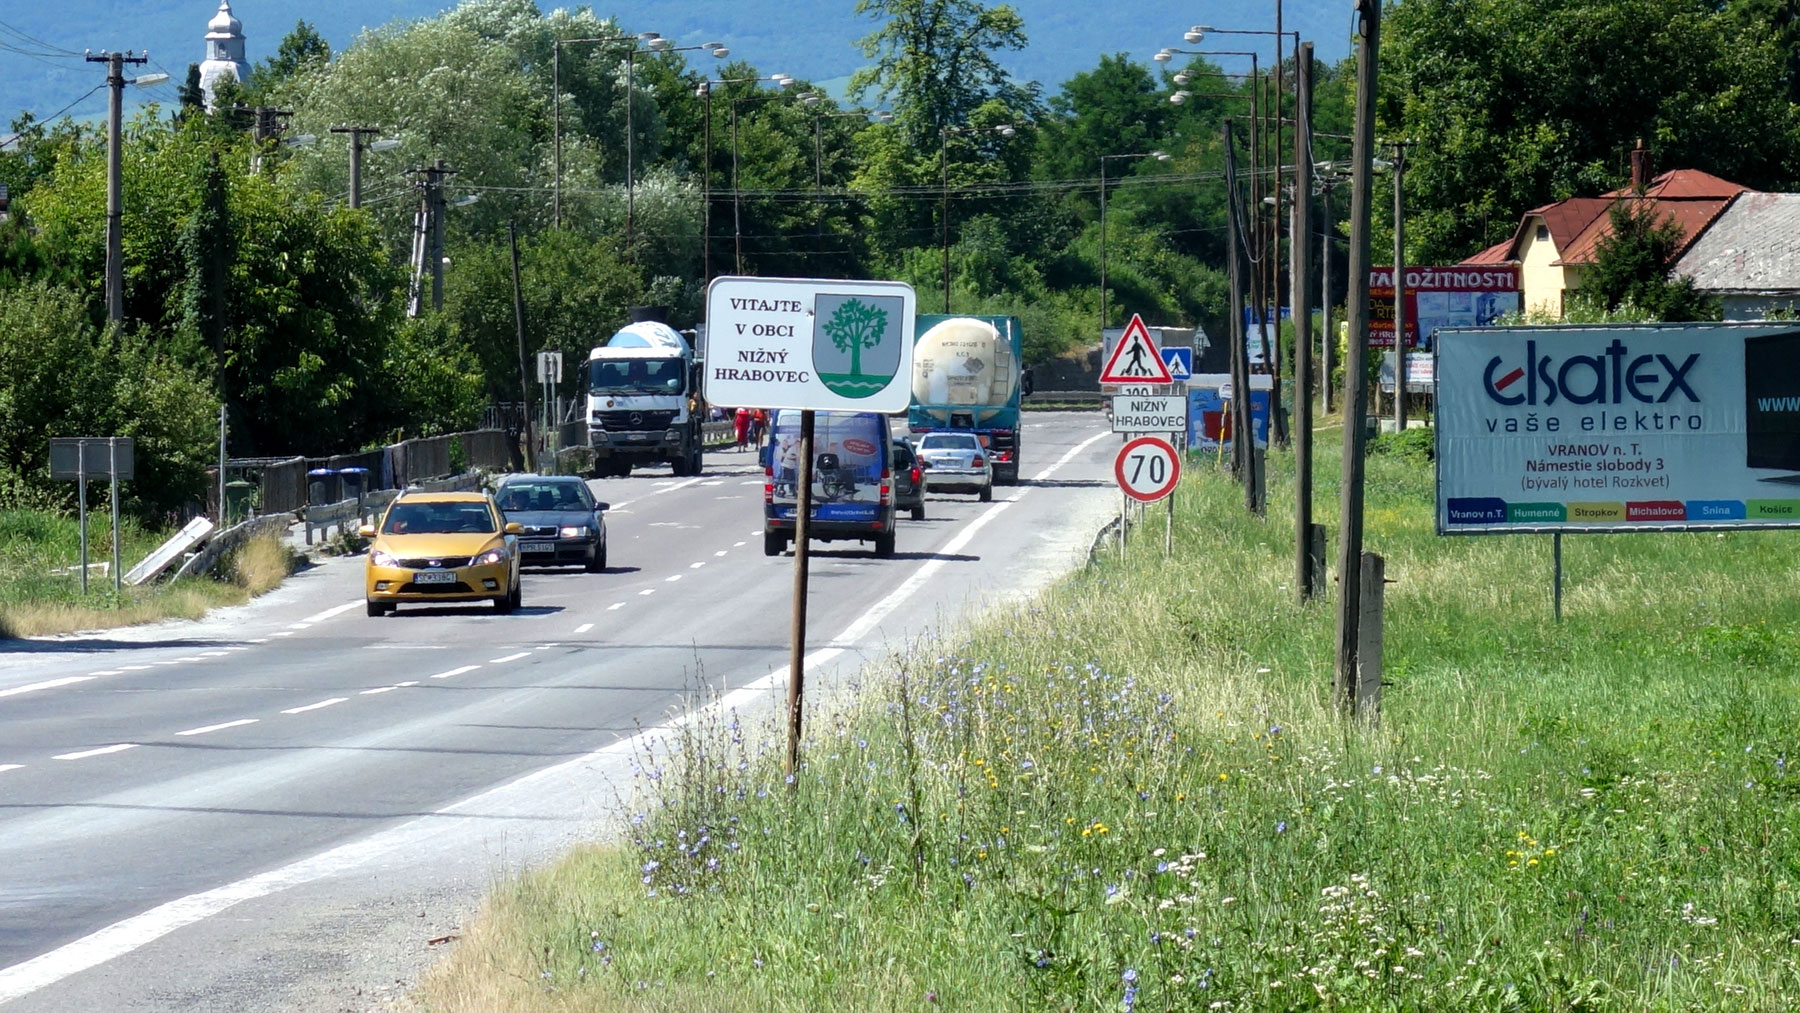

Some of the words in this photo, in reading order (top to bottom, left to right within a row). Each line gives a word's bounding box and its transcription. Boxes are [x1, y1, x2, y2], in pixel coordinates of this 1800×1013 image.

[1369, 267, 1514, 289] TAOŽITNOSTI
[730, 298, 802, 312] VITAJTE
[735, 323, 747, 335] V
[752, 324, 794, 338] OBCI
[738, 348, 788, 364] NIŽNÝ
[715, 368, 810, 383] HRABOVEC
[1131, 399, 1168, 412] NIŽNÝ
[1116, 416, 1185, 427] HRABOVEC
[1487, 414, 1560, 433] vaše
[1581, 411, 1702, 431] elektro
[1548, 444, 1609, 456] VRANOV
[1613, 446, 1626, 456] n.
[1629, 444, 1642, 455] T.
[1131, 455, 1165, 484] 70
[1526, 458, 1592, 472] Námestie
[1597, 459, 1651, 474] slobody
[1655, 459, 1665, 471] 3
[1521, 475, 1568, 491] (bývalý
[1573, 475, 1608, 488] hotel
[1612, 474, 1670, 490] Rozkvet)
[1450, 509, 1484, 519] Vranov
[1486, 508, 1504, 519] n.T.
[1514, 506, 1560, 518] Humenné
[1575, 506, 1618, 519] Stropkov
[1629, 505, 1684, 517] Michalovce
[1702, 505, 1731, 516] Snina
[1759, 502, 1793, 514] Košice
